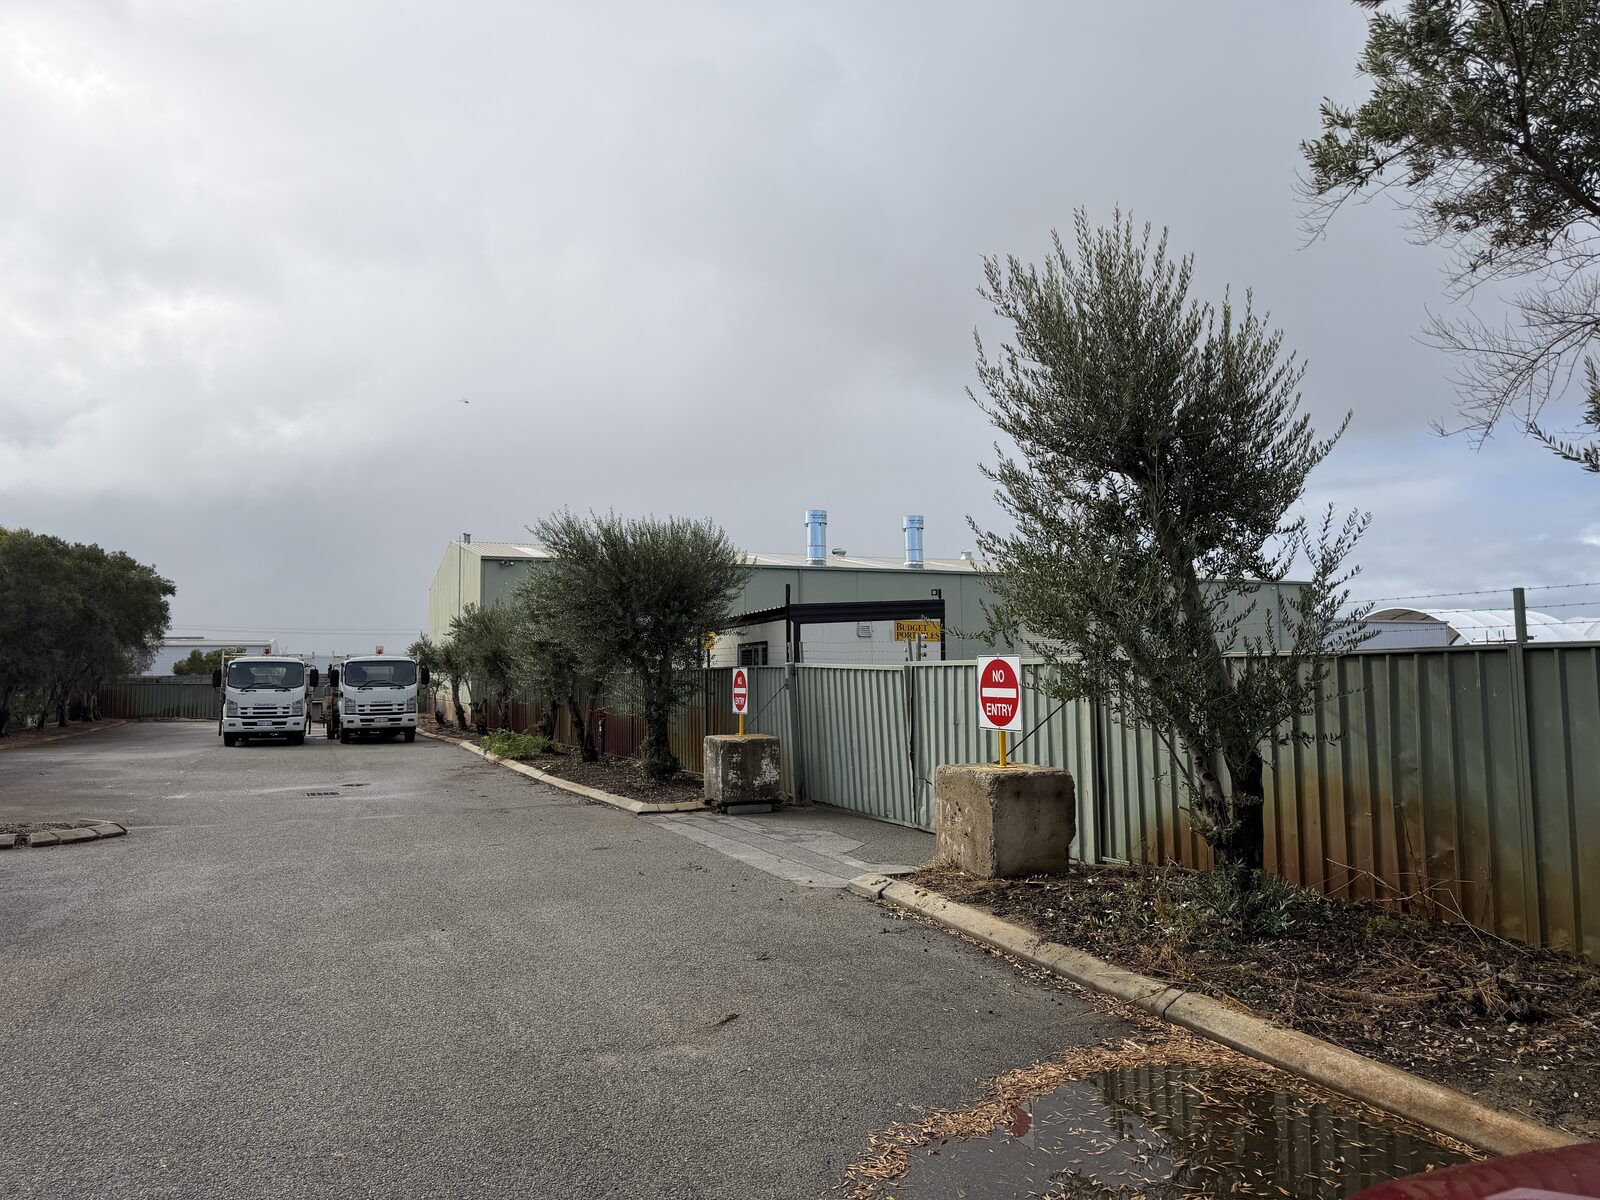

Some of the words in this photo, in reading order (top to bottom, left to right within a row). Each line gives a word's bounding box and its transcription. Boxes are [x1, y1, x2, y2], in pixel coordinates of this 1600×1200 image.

[896, 622, 928, 631] BUDGET
[737, 676, 743, 685] NO
[992, 669, 1005, 683] NO
[735, 697, 744, 705] ENTRY
[986, 703, 1013, 717] ENTRY
